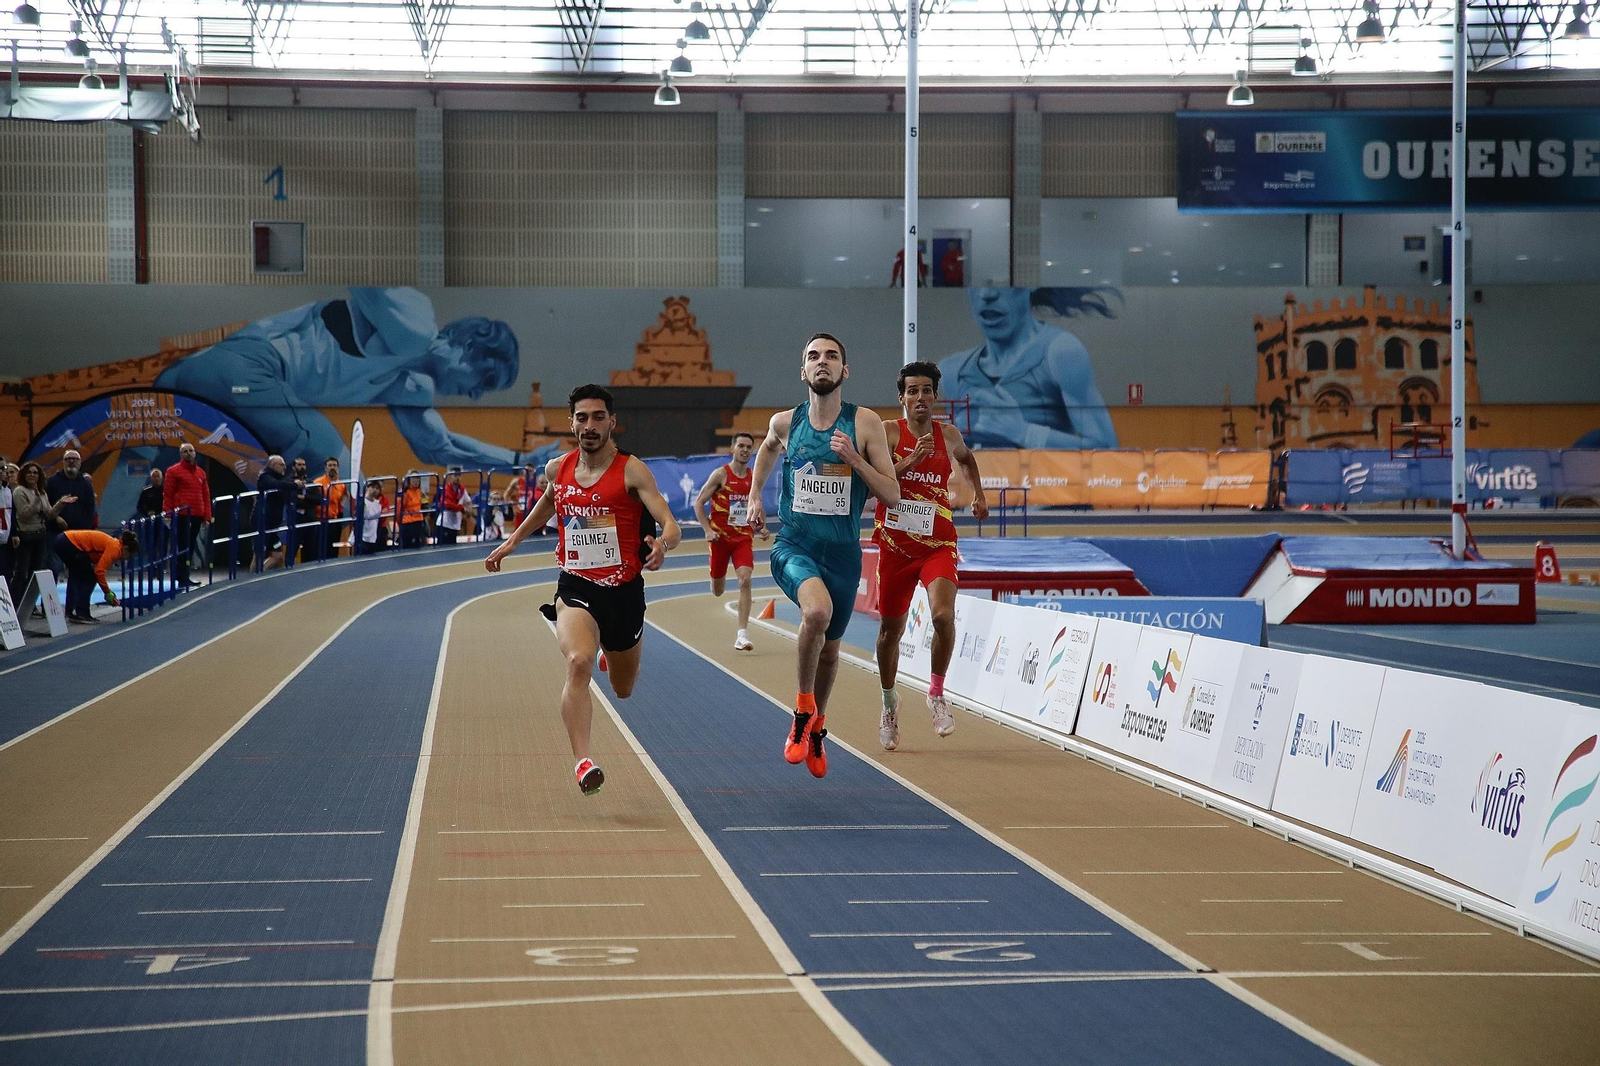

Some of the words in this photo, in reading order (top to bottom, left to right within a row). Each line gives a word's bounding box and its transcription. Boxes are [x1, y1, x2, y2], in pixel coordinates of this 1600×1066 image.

[910, 127, 917, 137] 5
[1455, 123, 1462, 133] 5
[1277, 143, 1324, 151] OURENSE
[1362, 139, 1600, 179] OURENSE
[264, 164, 288, 201] 1
[909, 226, 916, 235] 4
[1454, 221, 1462, 231] 4
[908, 323, 915, 332] 3
[1454, 320, 1462, 330] 3
[132, 399, 155, 407] 2026
[105, 410, 141, 418] VIRTUS
[143, 408, 183, 417] WORLD
[109, 421, 143, 430] SHORT
[144, 420, 180, 428] TRACK
[1454, 418, 1462, 428] 2
[105, 430, 184, 441] CHAMPIONSHIP
[901, 471, 941, 484] SPAÑA
[1475, 467, 1537, 490] virtus
[801, 479, 845, 494] ANGELOV
[835, 497, 846, 507] 55
[562, 503, 610, 517] TÜRKİYE
[922, 520, 930, 529] 16
[571, 533, 608, 546] EGILMEZ
[604, 548, 614, 558] 97
[1542, 555, 1555, 577] 8
[1369, 588, 1472, 608] MONDO
[1121, 703, 1168, 743] Expourense
[1190, 708, 1214, 734] OURENSE
[1340, 726, 1363, 747] DEPORTE
[1335, 751, 1357, 771] GALEGO
[524, 946, 639, 967] 3
[913, 941, 1036, 963] 2
[1300, 941, 1424, 961] 1
[123, 953, 250, 975] 4
